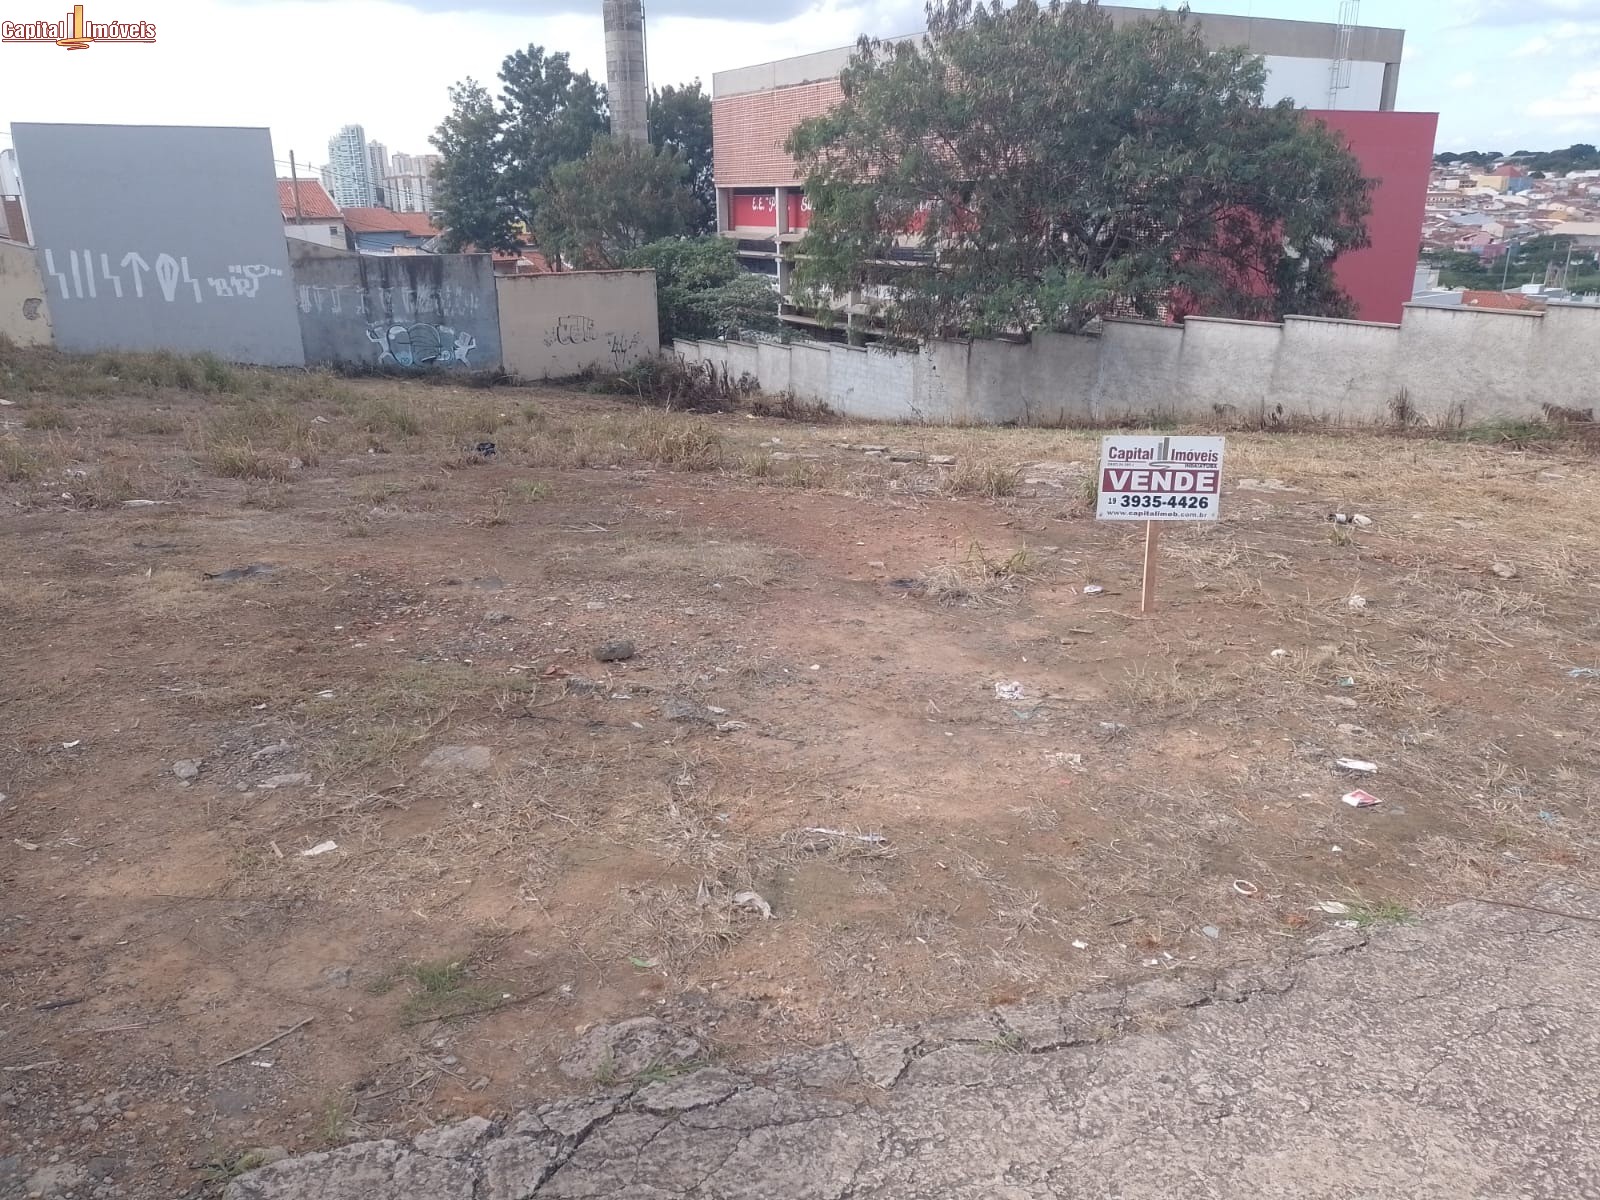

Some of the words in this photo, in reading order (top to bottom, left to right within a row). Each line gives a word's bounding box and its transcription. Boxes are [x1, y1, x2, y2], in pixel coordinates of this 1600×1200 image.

[1108, 446, 1154, 462] Capital
[1171, 448, 1219, 462] Imóveis
[1108, 470, 1215, 492] VENDE
[1108, 497, 1117, 505] 19
[1120, 495, 1209, 509] 3935-4426
[1107, 510, 1208, 518] www.capitalimob.com.br
